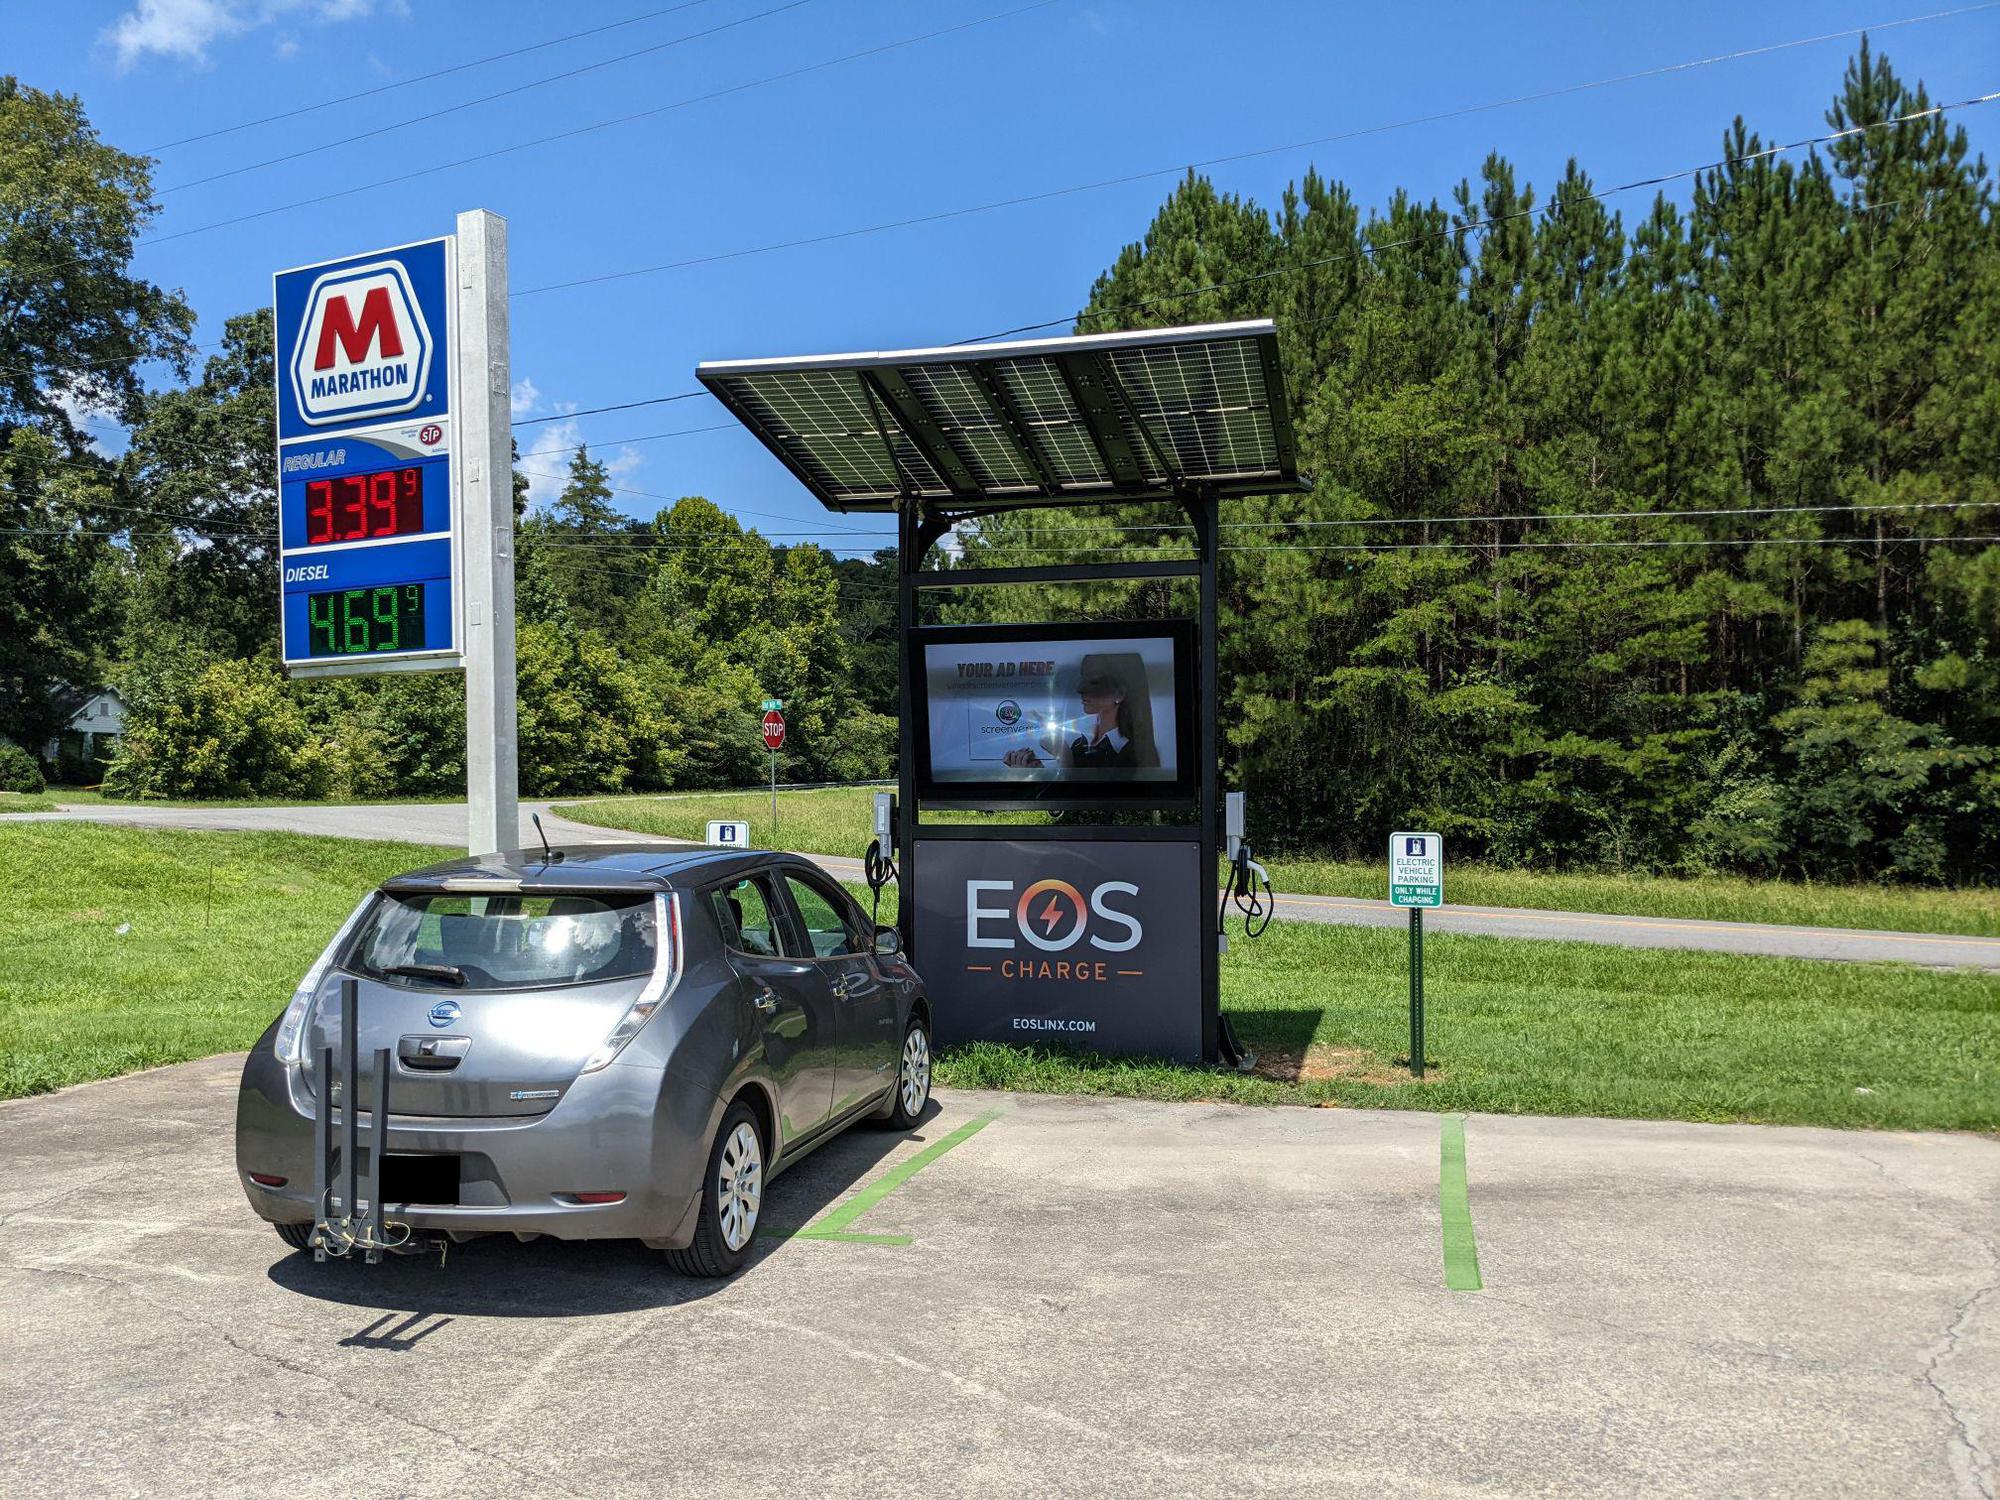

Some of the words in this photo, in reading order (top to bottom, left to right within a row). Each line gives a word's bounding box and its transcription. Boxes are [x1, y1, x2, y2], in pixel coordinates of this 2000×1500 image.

[314, 286, 405, 371] M
[310, 363, 408, 399] MARATHON
[421, 427, 440, 442] STP
[283, 449, 346, 472] REGULAR
[285, 564, 330, 583] DIESEL
[957, 663, 993, 678] YOUR
[996, 662, 1016, 677] AD
[1019, 661, 1055, 676] HERE
[764, 722, 784, 737] STOP
[1397, 876, 1434, 884] PARKING
[1395, 887, 1413, 895] ONLY
[1416, 887, 1437, 895] WHILE
[1398, 896, 1434, 904] CHARGING
[967, 879, 1143, 952] EOS
[1001, 960, 1107, 981] CHARGE
[1013, 1018, 1096, 1032] EOSLINX.COM
